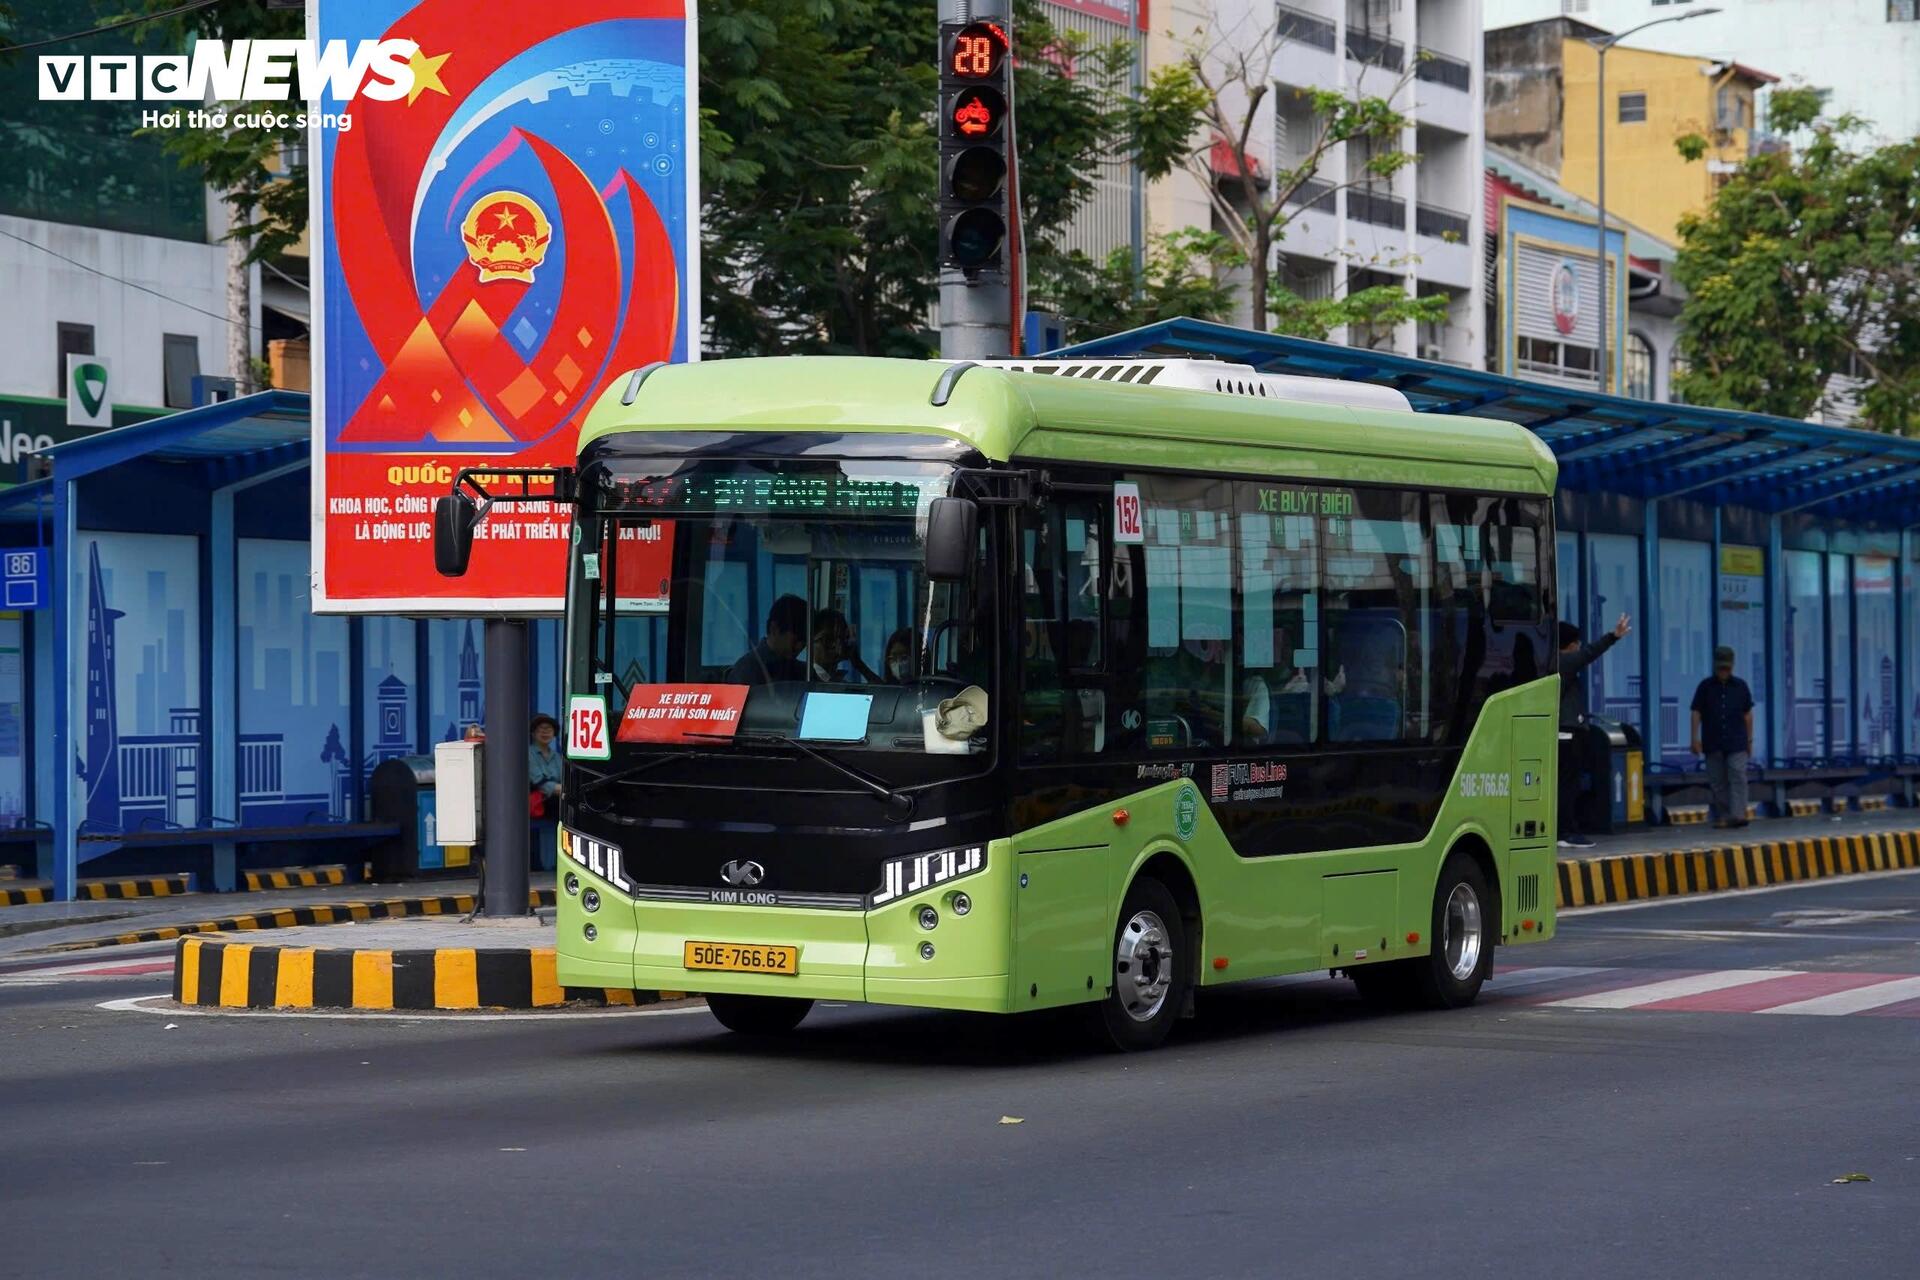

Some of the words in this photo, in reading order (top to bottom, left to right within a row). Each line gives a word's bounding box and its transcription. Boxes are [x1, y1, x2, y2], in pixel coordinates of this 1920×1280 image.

[954, 36, 990, 74] 28
[387, 460, 452, 485] QUỐC
[330, 497, 362, 514] KHOA
[364, 497, 392, 517] HỌC,
[395, 494, 428, 514] CÔNG
[1258, 488, 1277, 512] XE
[1116, 495, 1140, 535] 152
[355, 519, 370, 540] LÀ
[372, 520, 406, 543] ĐỘNG
[408, 521, 431, 543] LỰC
[491, 519, 522, 540] PHÁT
[524, 517, 559, 540] TRIỂN
[11, 555, 30, 574] 86
[658, 693, 673, 705] XE
[700, 693, 712, 705] ĐI
[627, 706, 648, 719] SÂN
[647, 708, 668, 719] BAY
[668, 706, 688, 719] TÂN
[688, 707, 709, 720] SƠN
[710, 706, 738, 721] NHẤT
[571, 709, 603, 749] 152
[711, 890, 737, 903] KIM
[740, 892, 776, 905] LONG
[694, 946, 787, 969] 50E-766.62
